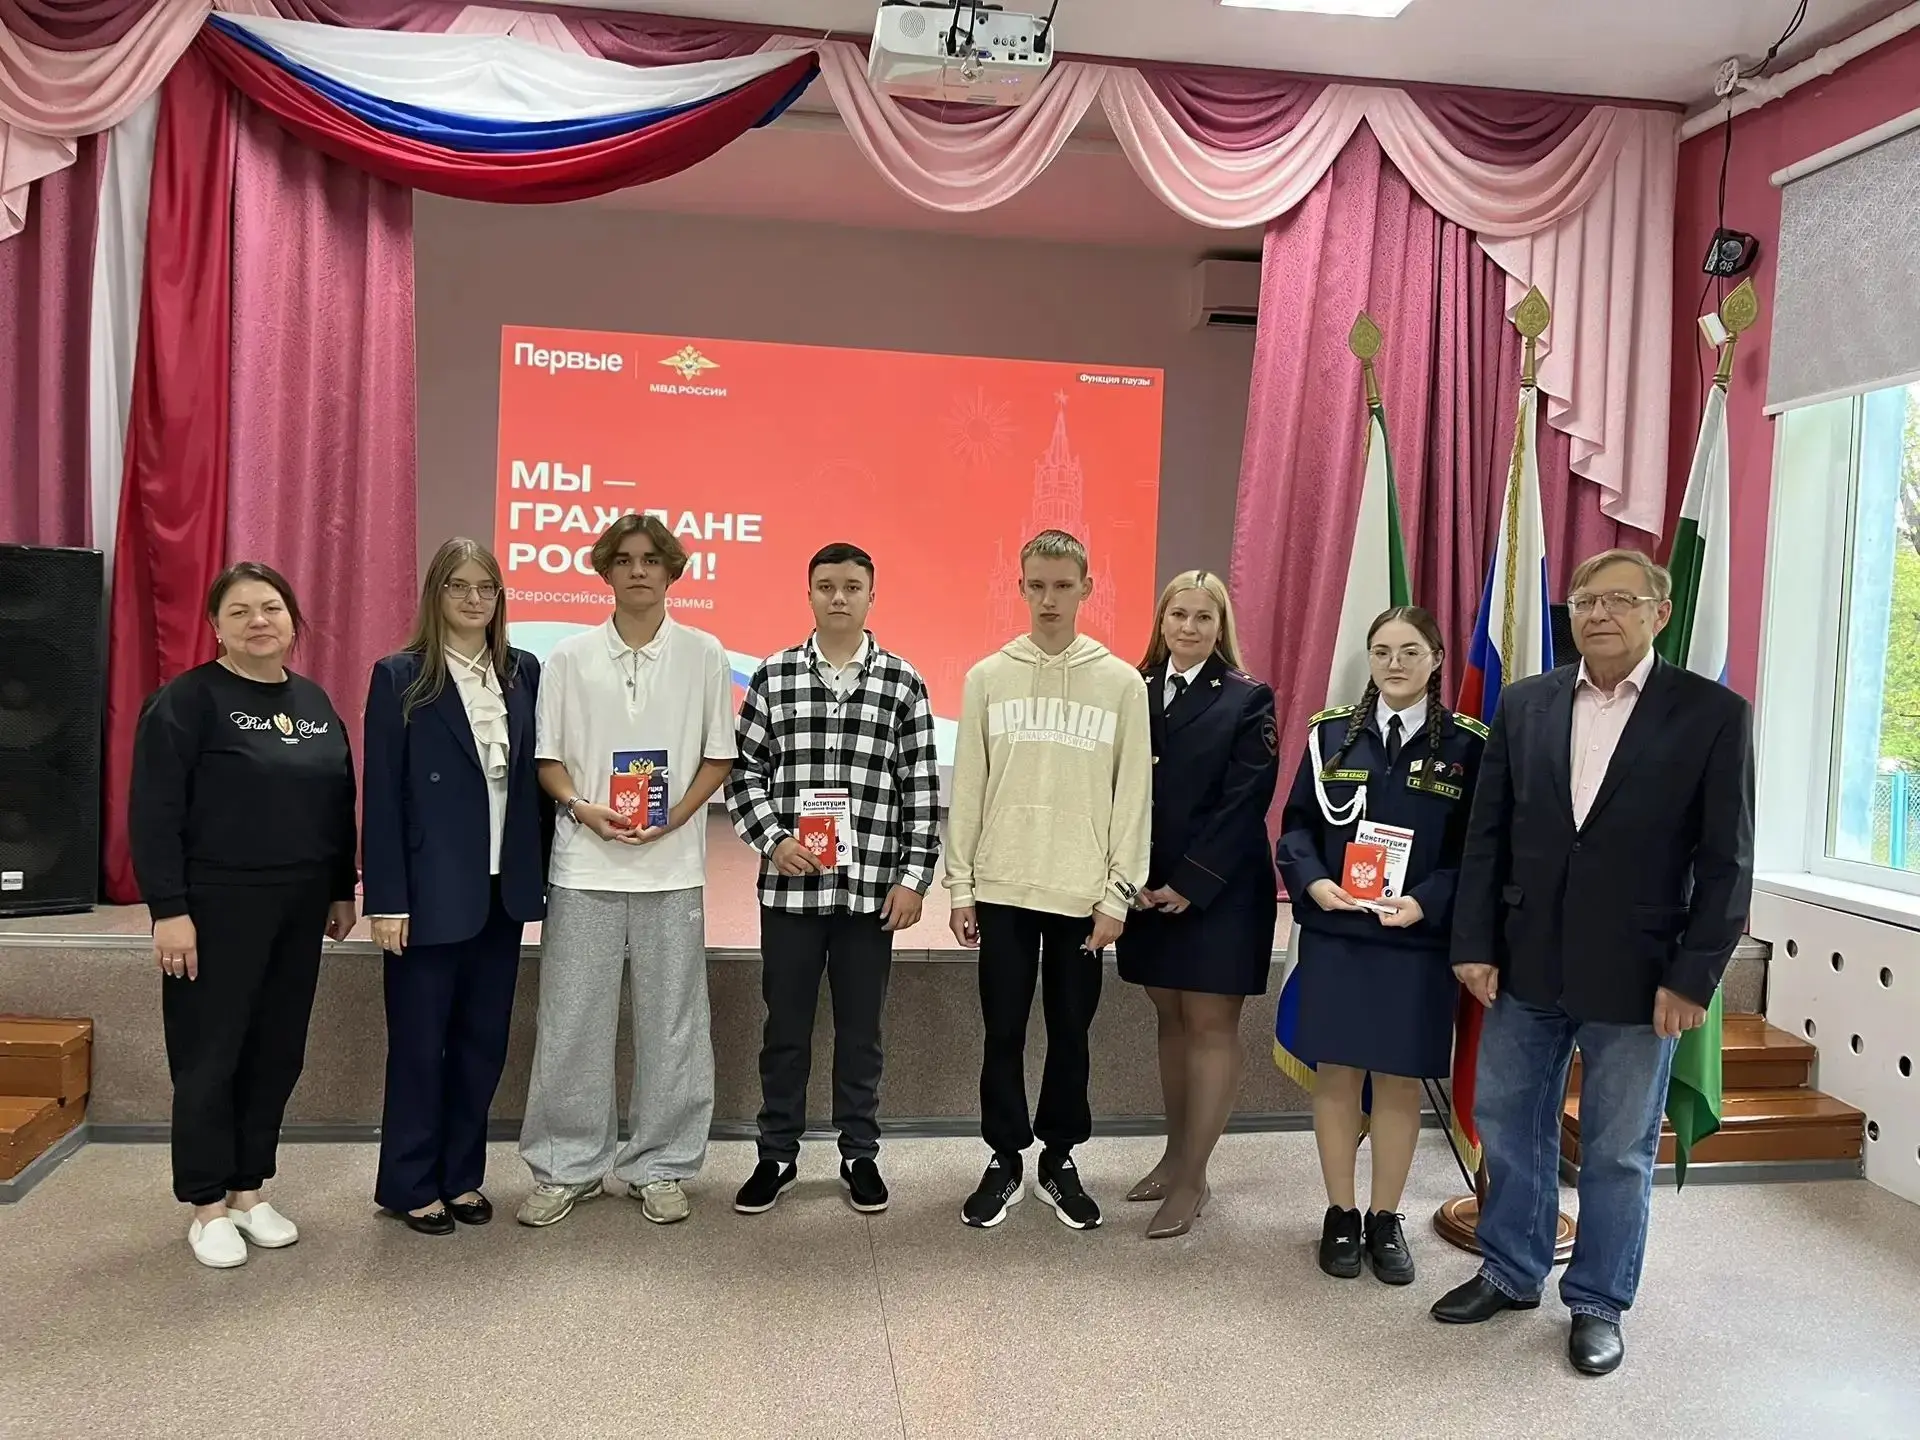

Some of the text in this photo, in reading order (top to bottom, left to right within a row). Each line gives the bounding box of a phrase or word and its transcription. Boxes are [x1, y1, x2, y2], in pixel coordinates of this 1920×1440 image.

[514, 341, 623, 375] Первые
[1079, 373, 1151, 387] Функция паузы
[649, 383, 727, 397] МВД РОССИИ
[510, 460, 592, 492] МЫ
[508, 543, 717, 581] РОСИ!
[505, 587, 616, 606] Всероссийска
[1004, 697, 1103, 741] PUMA
[296, 719, 329, 739] Soul
[803, 800, 846, 808] Конституция
[1359, 832, 1408, 848] Конституция
